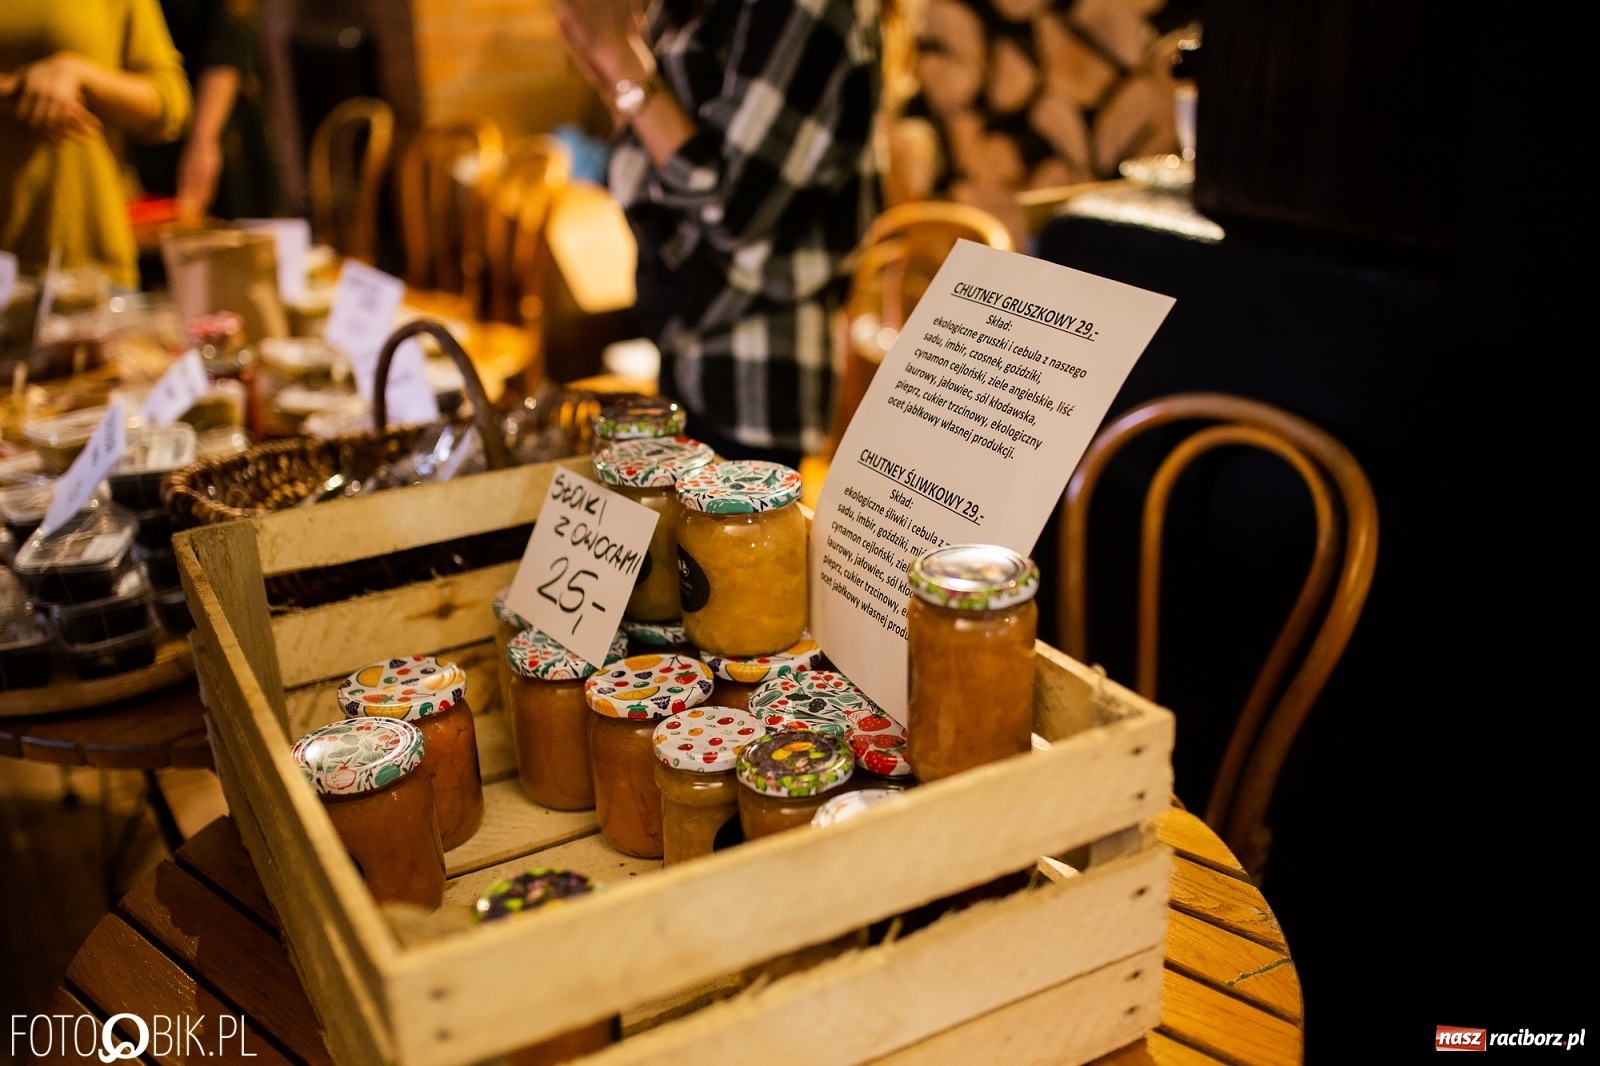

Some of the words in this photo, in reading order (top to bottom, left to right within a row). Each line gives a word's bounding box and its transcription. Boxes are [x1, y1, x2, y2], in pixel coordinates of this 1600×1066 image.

[953, 281, 1003, 306] CHUTNEY
[1001, 296, 1077, 330] GRUSZKOWY
[1074, 319, 1099, 341] 29,-
[985, 314, 1013, 332] Skład:
[923, 331, 943, 348] sadu,
[944, 339, 967, 357] imbir,
[968, 350, 1003, 370] czosnek,
[1002, 361, 1042, 385] goździki,
[932, 316, 978, 340] ekologiczne
[976, 333, 1010, 351] gruszki
[1007, 341, 1014, 352] i
[1012, 344, 1042, 362] cebula
[1042, 355, 1049, 365] z
[1048, 358, 1087, 379] naszego
[904, 363, 937, 385] laurowy,
[937, 376, 974, 400] jałowiec,
[974, 391, 989, 404] sól
[989, 397, 1037, 427] kłodawska,
[913, 348, 950, 368] cynamon
[949, 361, 986, 385] cejloński,
[987, 376, 1009, 391] ziele
[1008, 385, 1054, 411] angielskie,
[1055, 400, 1075, 417] liść
[887, 395, 906, 410] ocet
[903, 401, 941, 427] jabłkowy
[940, 420, 974, 442] własnej
[971, 432, 1015, 460] produkcji.
[895, 379, 921, 398] pieprz,
[922, 391, 948, 408] cukier
[947, 401, 989, 428] trzcinowy,
[990, 419, 1043, 451] ekologiczny
[859, 449, 906, 480] CHUTNEY
[904, 469, 965, 510] ŚLIWKOWY
[962, 500, 985, 523] 29,-
[889, 489, 914, 510] Skład:
[837, 503, 855, 522] sadu,
[855, 512, 876, 534] imbir,
[876, 526, 909, 553] goździki,
[843, 486, 885, 515] ekologiczne
[884, 505, 908, 528] śliwki
[906, 520, 913, 531] i
[911, 523, 939, 546] cebula
[937, 538, 945, 548] z
[570, 522, 642, 576] OWOCAMI
[826, 535, 854, 563] laurowy,
[853, 553, 885, 584] jałowiec,
[885, 575, 898, 587] sól
[831, 520, 862, 545] cynamon
[861, 540, 895, 567] cejloński,
[895, 559, 911, 575] ziel
[820, 571, 833, 585] ocet
[831, 579, 861, 608] jabłkowy
[860, 602, 888, 627] własnej
[886, 619, 909, 641] produ
[823, 554, 843, 576] pieprz,
[843, 568, 865, 588] cukier
[864, 582, 900, 614] trzcinowy,
